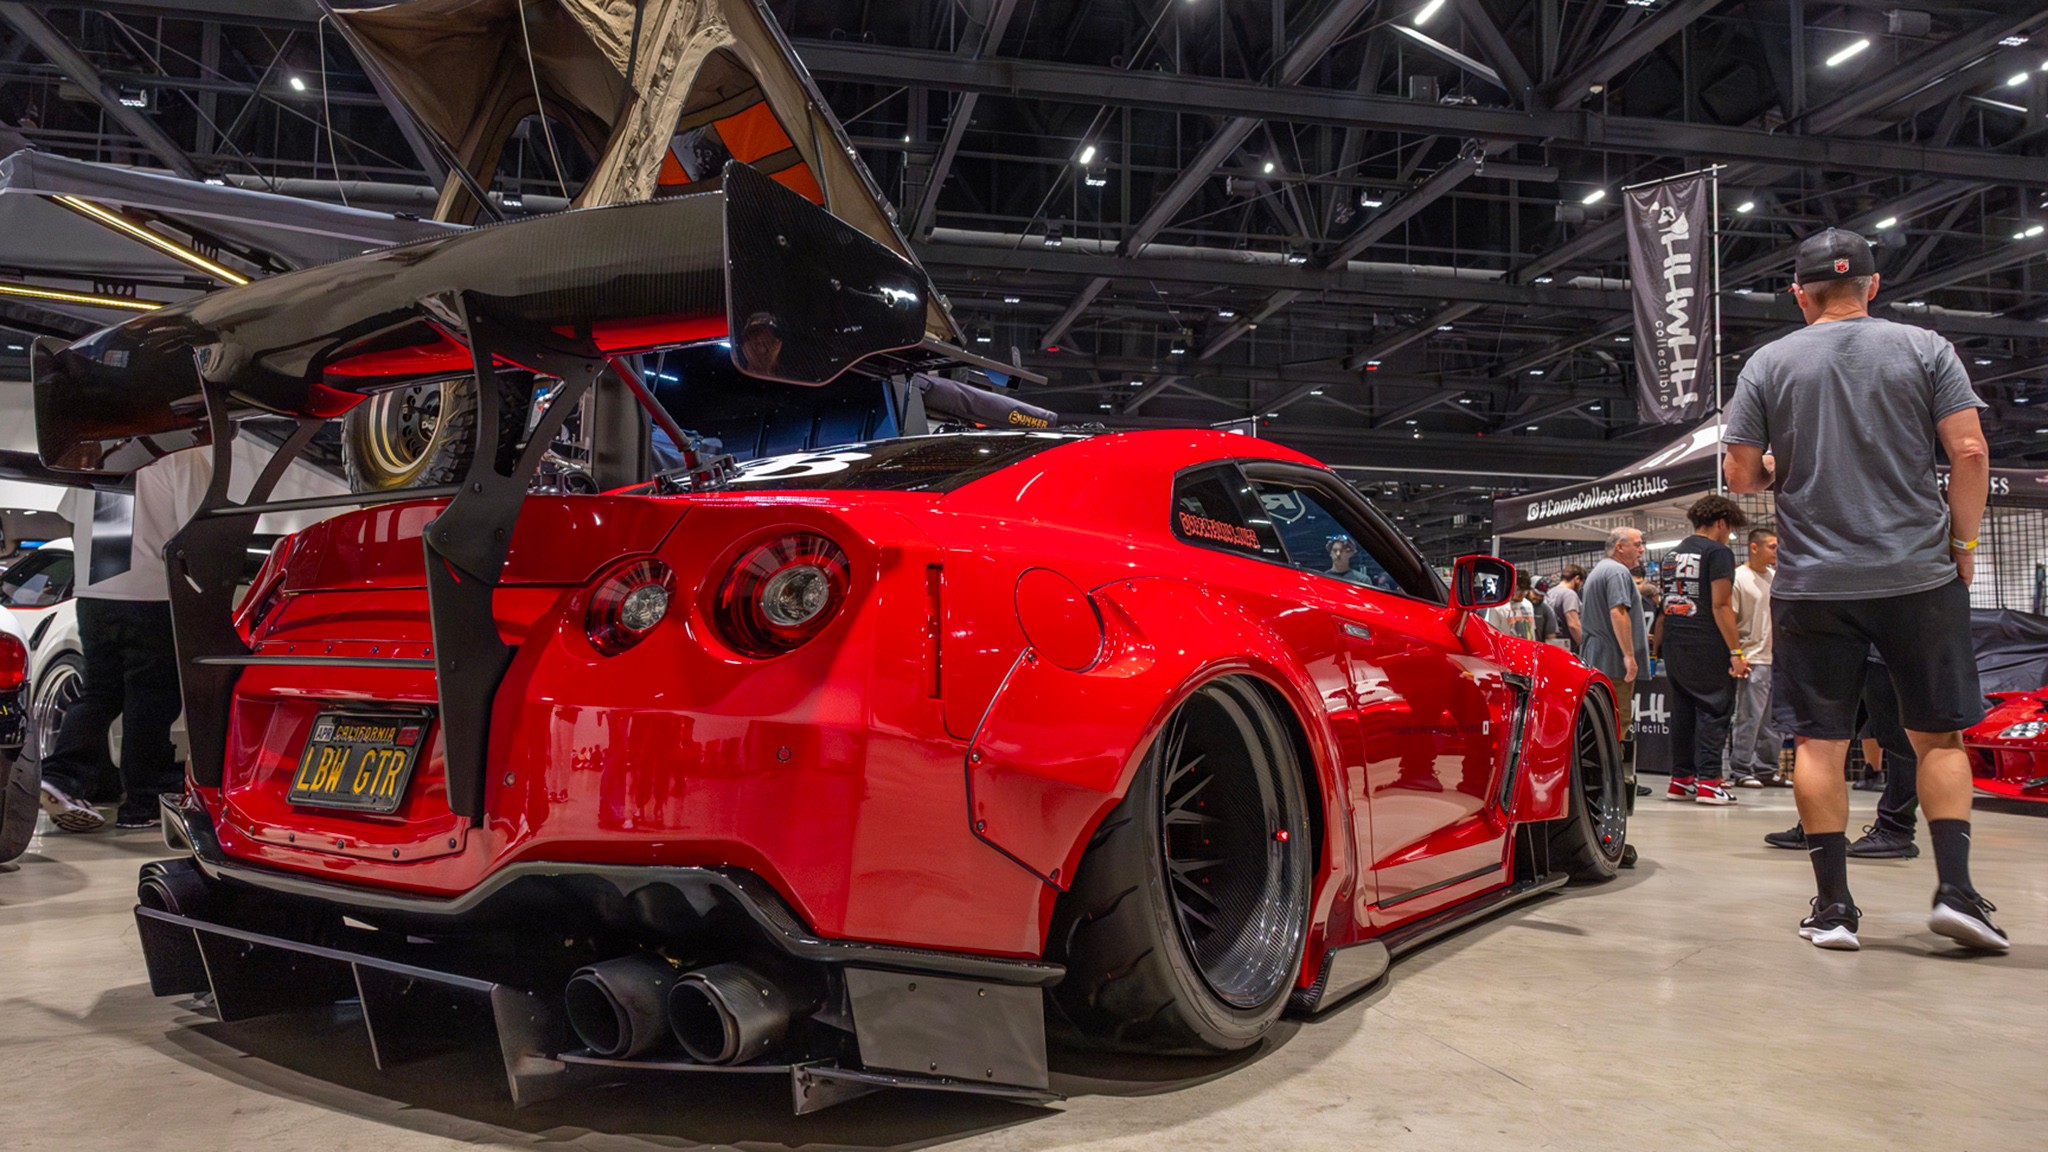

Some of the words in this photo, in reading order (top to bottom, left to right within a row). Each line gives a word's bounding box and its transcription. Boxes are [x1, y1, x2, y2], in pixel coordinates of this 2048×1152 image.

[1655, 320, 1671, 410] collectibles
[1008, 410, 1049, 429] BUNKER
[1539, 475, 1669, 519] #ComeCollectWithUs
[315, 726, 334, 740] APR
[335, 725, 397, 740] CALIFORNIA
[296, 746, 351, 793] LBW
[352, 748, 406, 797] GTR
